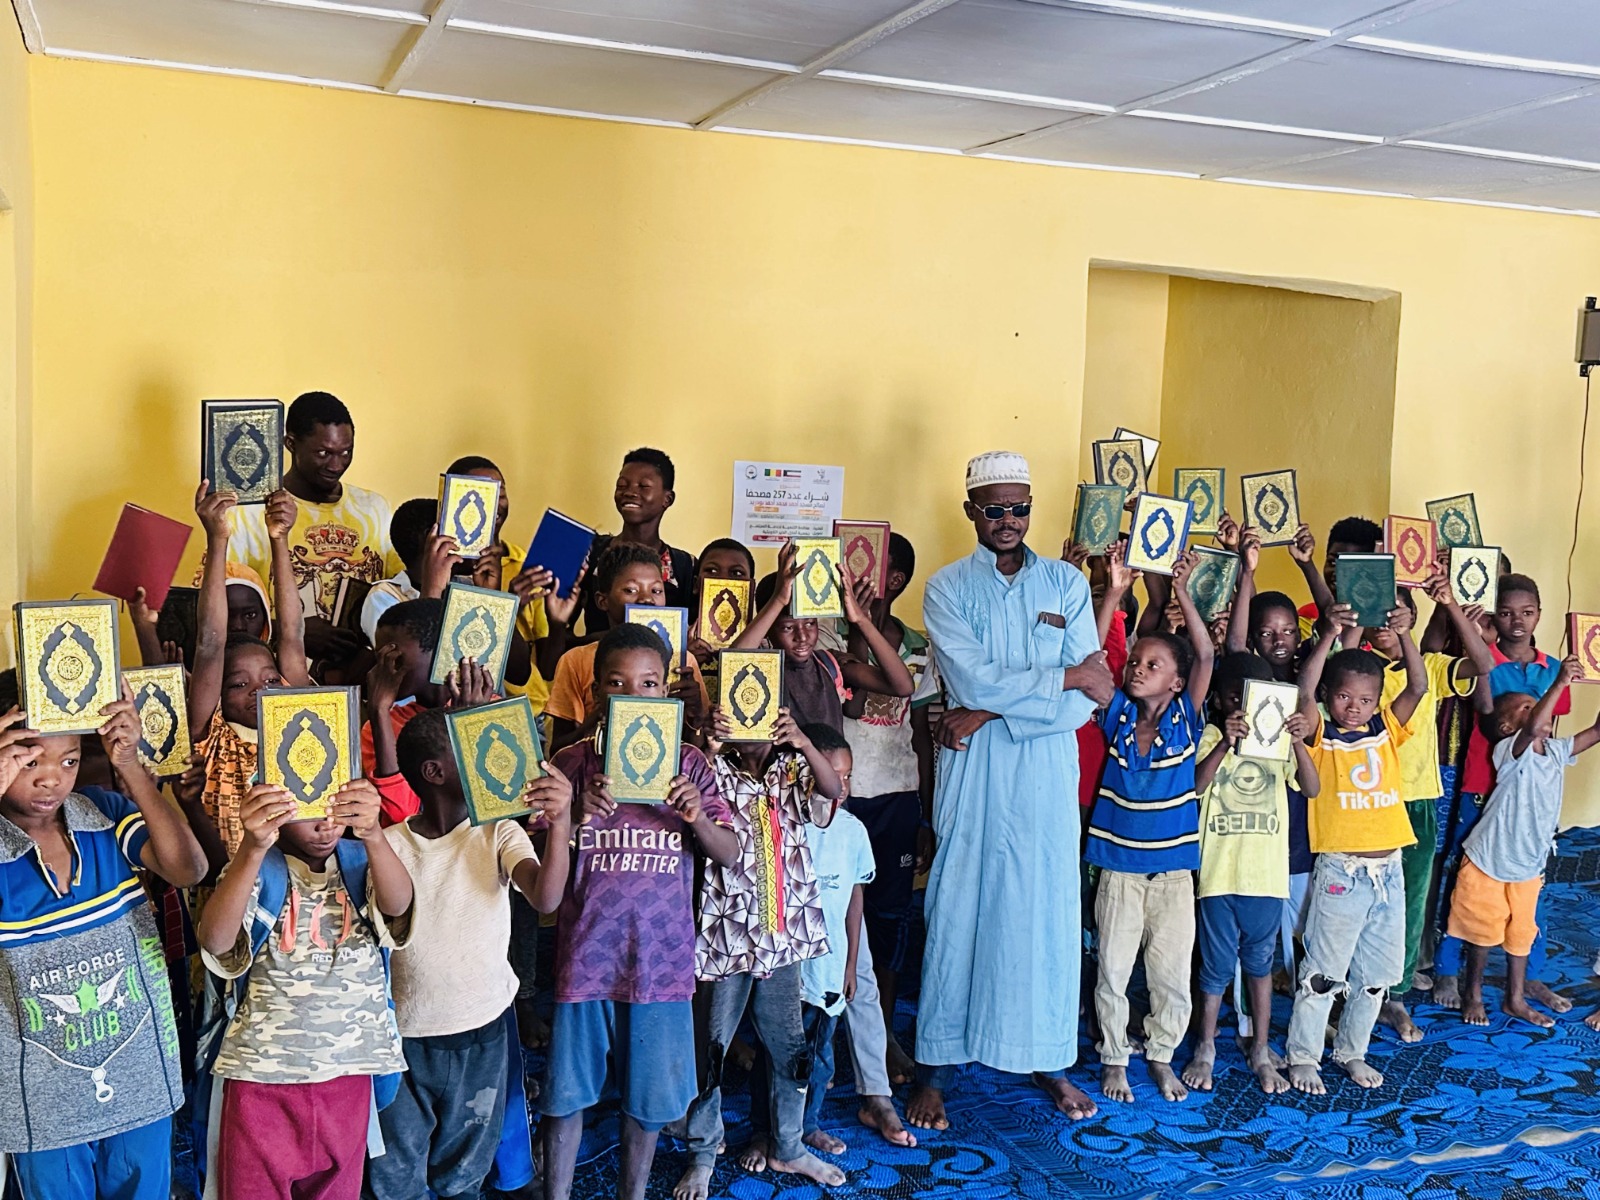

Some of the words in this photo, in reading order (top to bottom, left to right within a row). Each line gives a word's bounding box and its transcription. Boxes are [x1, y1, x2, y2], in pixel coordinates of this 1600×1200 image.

[773, 489, 786, 499] 257
[787, 492, 802, 500] عدد
[1215, 813, 1279, 835] BELLO
[590, 853, 620, 872] FLY
[621, 853, 679, 874] BETTER
[311, 953, 333, 963] RED
[29, 969, 61, 991] AIR
[65, 948, 126, 979] FORCE
[140, 937, 165, 976] AIR
[153, 975, 178, 1057] FORCE
[65, 1010, 120, 1051] CLUB
